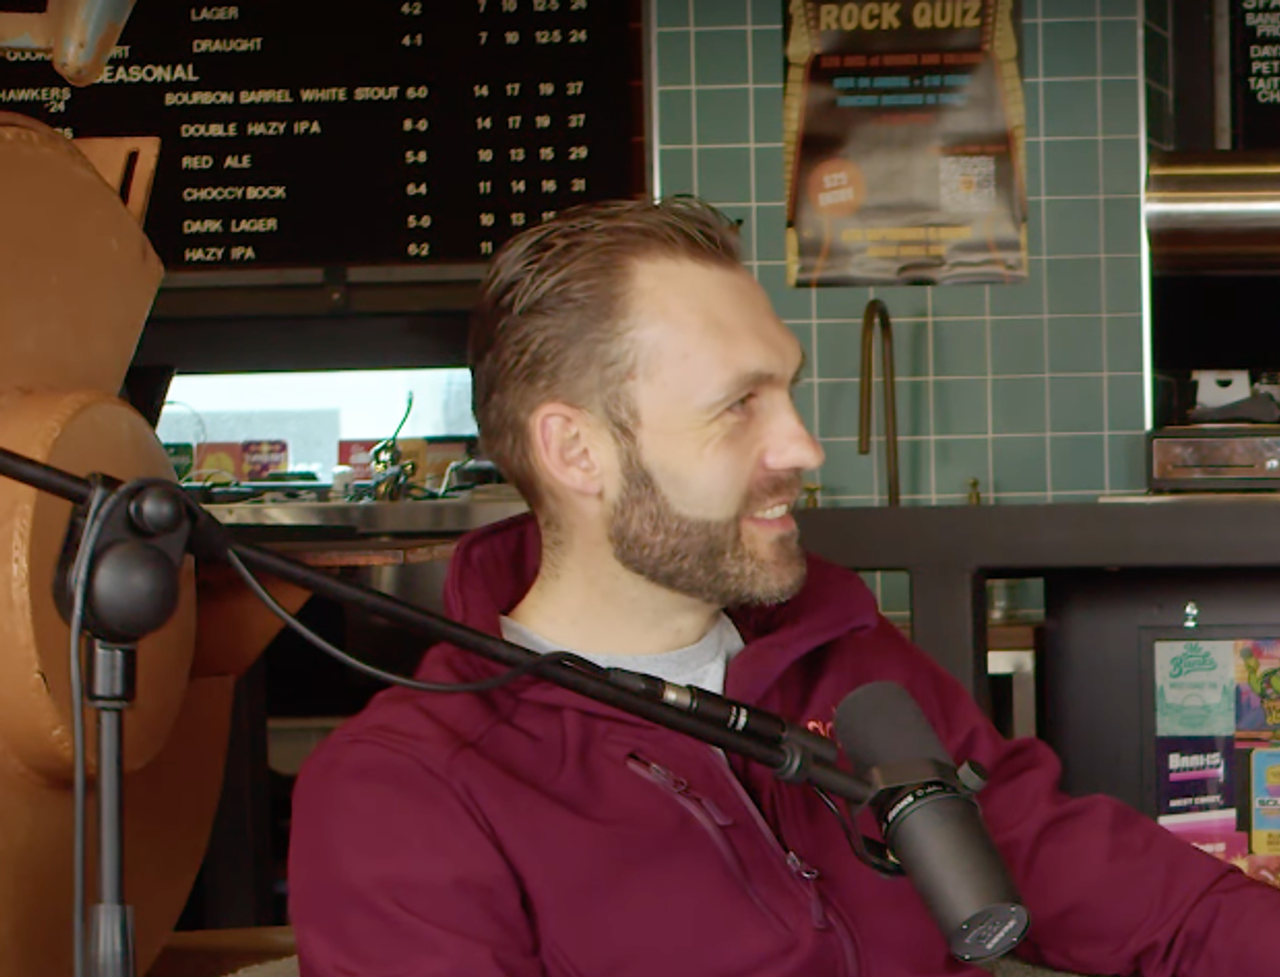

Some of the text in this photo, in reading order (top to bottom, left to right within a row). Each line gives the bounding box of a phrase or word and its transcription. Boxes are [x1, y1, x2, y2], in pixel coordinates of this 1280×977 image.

[190, 7, 239, 21] LAGER
[820, 2, 983, 30] ROCK QUIZ
[192, 37, 263, 53] DRAUGHT
[479, 31, 488, 45] 7
[505, 31, 520, 44] 10
[568, 29, 587, 43] 24
[97, 63, 199, 83] EASONAL
[1251, 61, 1280, 74] PET
[164, 90, 234, 106] BOURBON
[239, 88, 294, 103] BARREL
[300, 86, 348, 101] WHITE
[353, 86, 399, 100] STOUT
[473, 84, 489, 97] 14
[505, 82, 521, 96] 17
[566, 80, 584, 95] 37
[180, 123, 238, 137] DOUBLE
[247, 121, 287, 136] HAZY
[294, 120, 321, 135] IPA
[476, 116, 492, 130] 14
[508, 115, 522, 129] 17
[567, 113, 586, 128] 37
[182, 155, 213, 170] RED
[224, 154, 252, 169] ALE
[183, 186, 244, 201] CHOCCY
[246, 185, 286, 200] BOCK
[478, 180, 492, 194] 11
[511, 179, 526, 193] 14
[183, 218, 223, 234] DARK
[230, 217, 278, 233] LAGER
[184, 248, 224, 262] HAZY
[230, 246, 255, 261] IPA
[480, 241, 492, 255] 11
